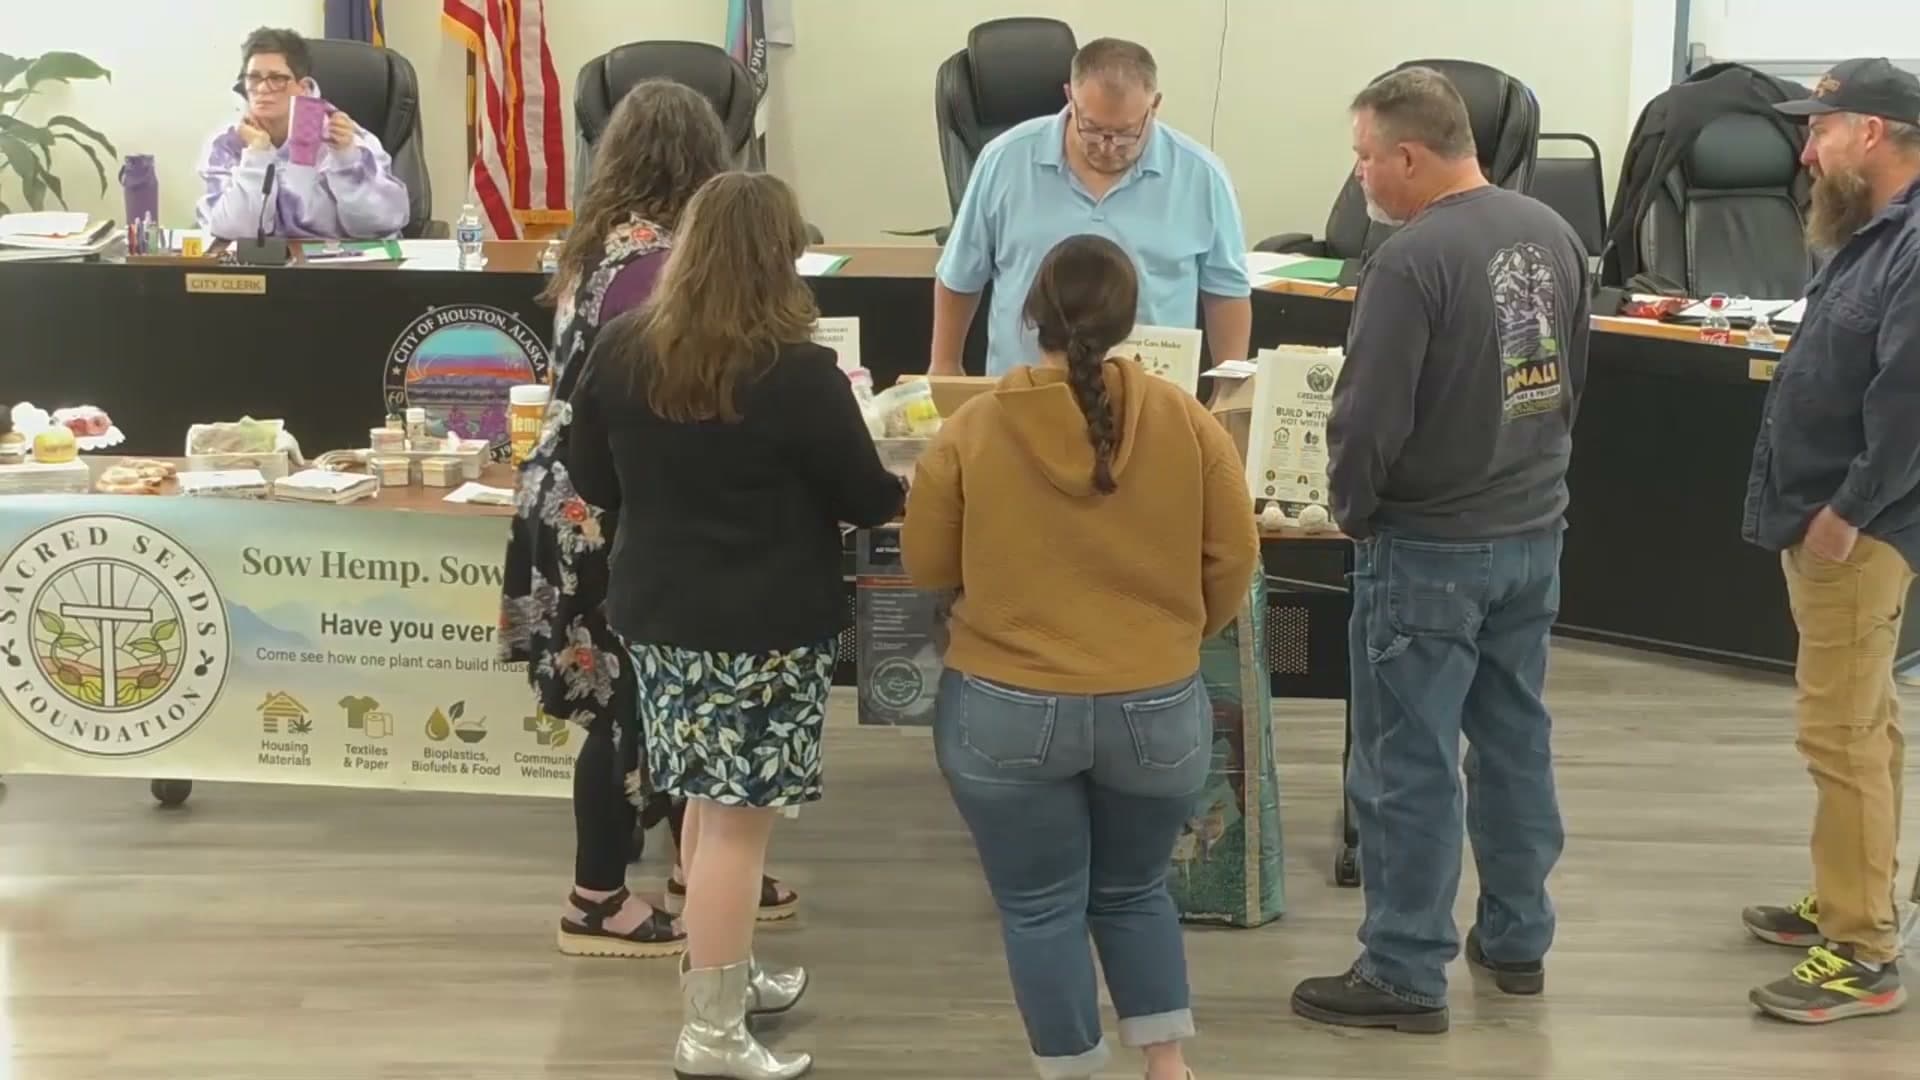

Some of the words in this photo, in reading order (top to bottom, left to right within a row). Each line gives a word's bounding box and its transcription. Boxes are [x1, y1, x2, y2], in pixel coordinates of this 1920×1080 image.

[191, 279, 217, 289] CITY
[223, 280, 261, 290] CLERK
[394, 332, 419, 364] CITY
[417, 319, 435, 335] OF
[509, 324, 545, 371] ALASKA
[1160, 339, 1181, 349] Make
[1276, 406, 1303, 418] BUILD
[1306, 409, 1328, 419] WITH
[241, 547, 313, 577] Sow
[320, 550, 430, 588] Hemp.
[439, 555, 506, 587] Sow
[0, 526, 109, 625] SACRED
[133, 535, 216, 637] SEEDS
[321, 612, 383, 637] Have
[390, 618, 434, 644] you
[441, 622, 497, 643] ever
[256, 647, 297, 663] Come
[300, 651, 324, 664] see
[327, 650, 357, 666] how
[360, 654, 386, 667] one
[389, 653, 424, 670] plant
[426, 657, 452, 670] can
[455, 656, 489, 672] build
[492, 657, 529, 672] hous
[15, 680, 201, 743] FOUNDATION
[261, 739, 309, 755] Housing
[345, 743, 389, 756] Textiles
[423, 747, 489, 763] Bioplastics,
[258, 753, 312, 767] Materials
[343, 757, 353, 768] &
[355, 757, 390, 771] Paper
[411, 760, 458, 774] Biofuels
[460, 763, 469, 775] &
[472, 763, 501, 776] Food
[513, 751, 577, 769] Community
[520, 766, 572, 780] Wellness
